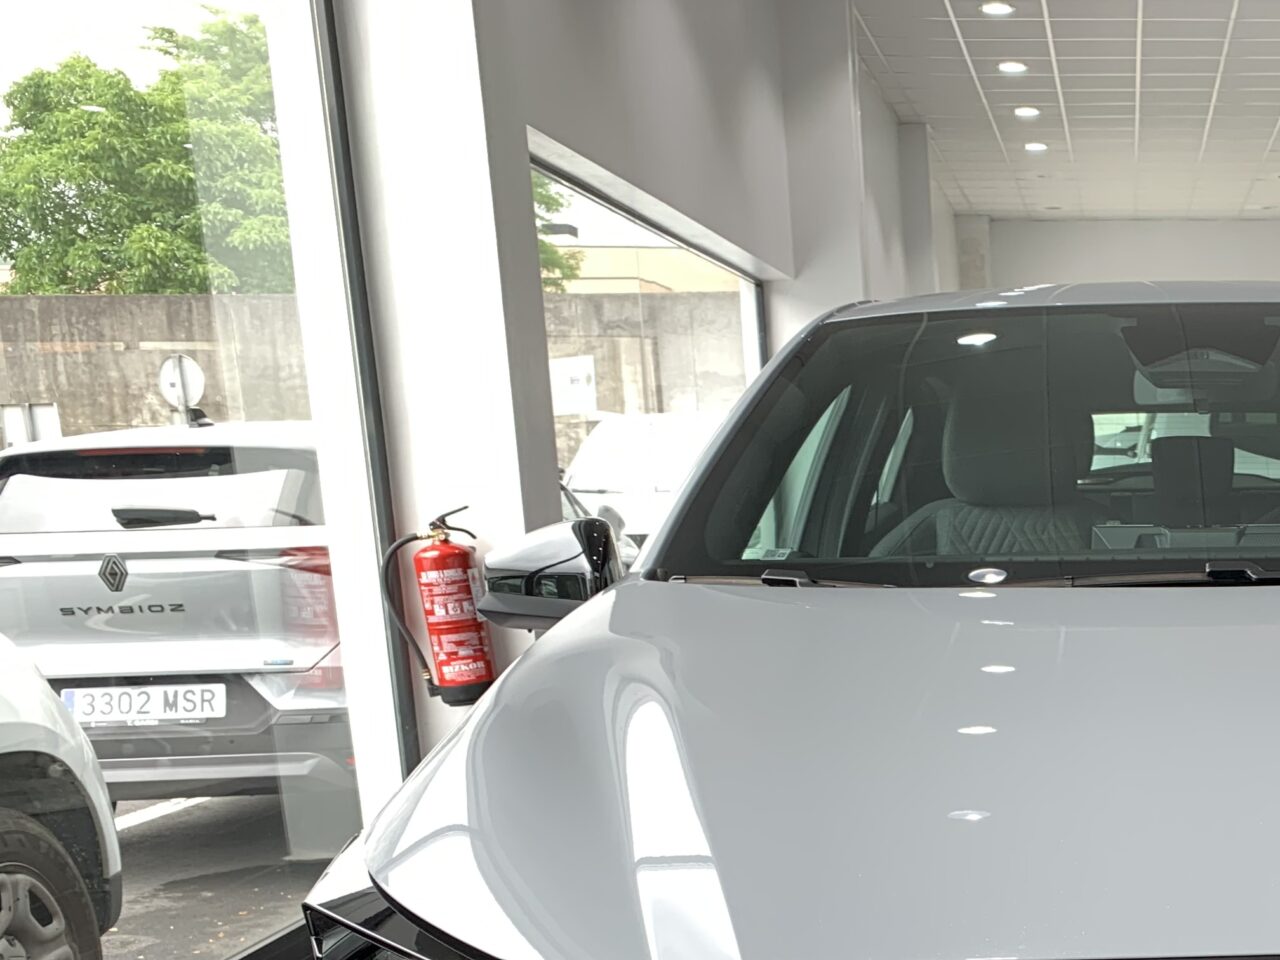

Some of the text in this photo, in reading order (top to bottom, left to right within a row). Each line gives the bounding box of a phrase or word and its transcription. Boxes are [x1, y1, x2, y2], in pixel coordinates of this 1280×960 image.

[59, 603, 186, 616] SYMBIOZ
[82, 689, 216, 716] 3302 MSR
